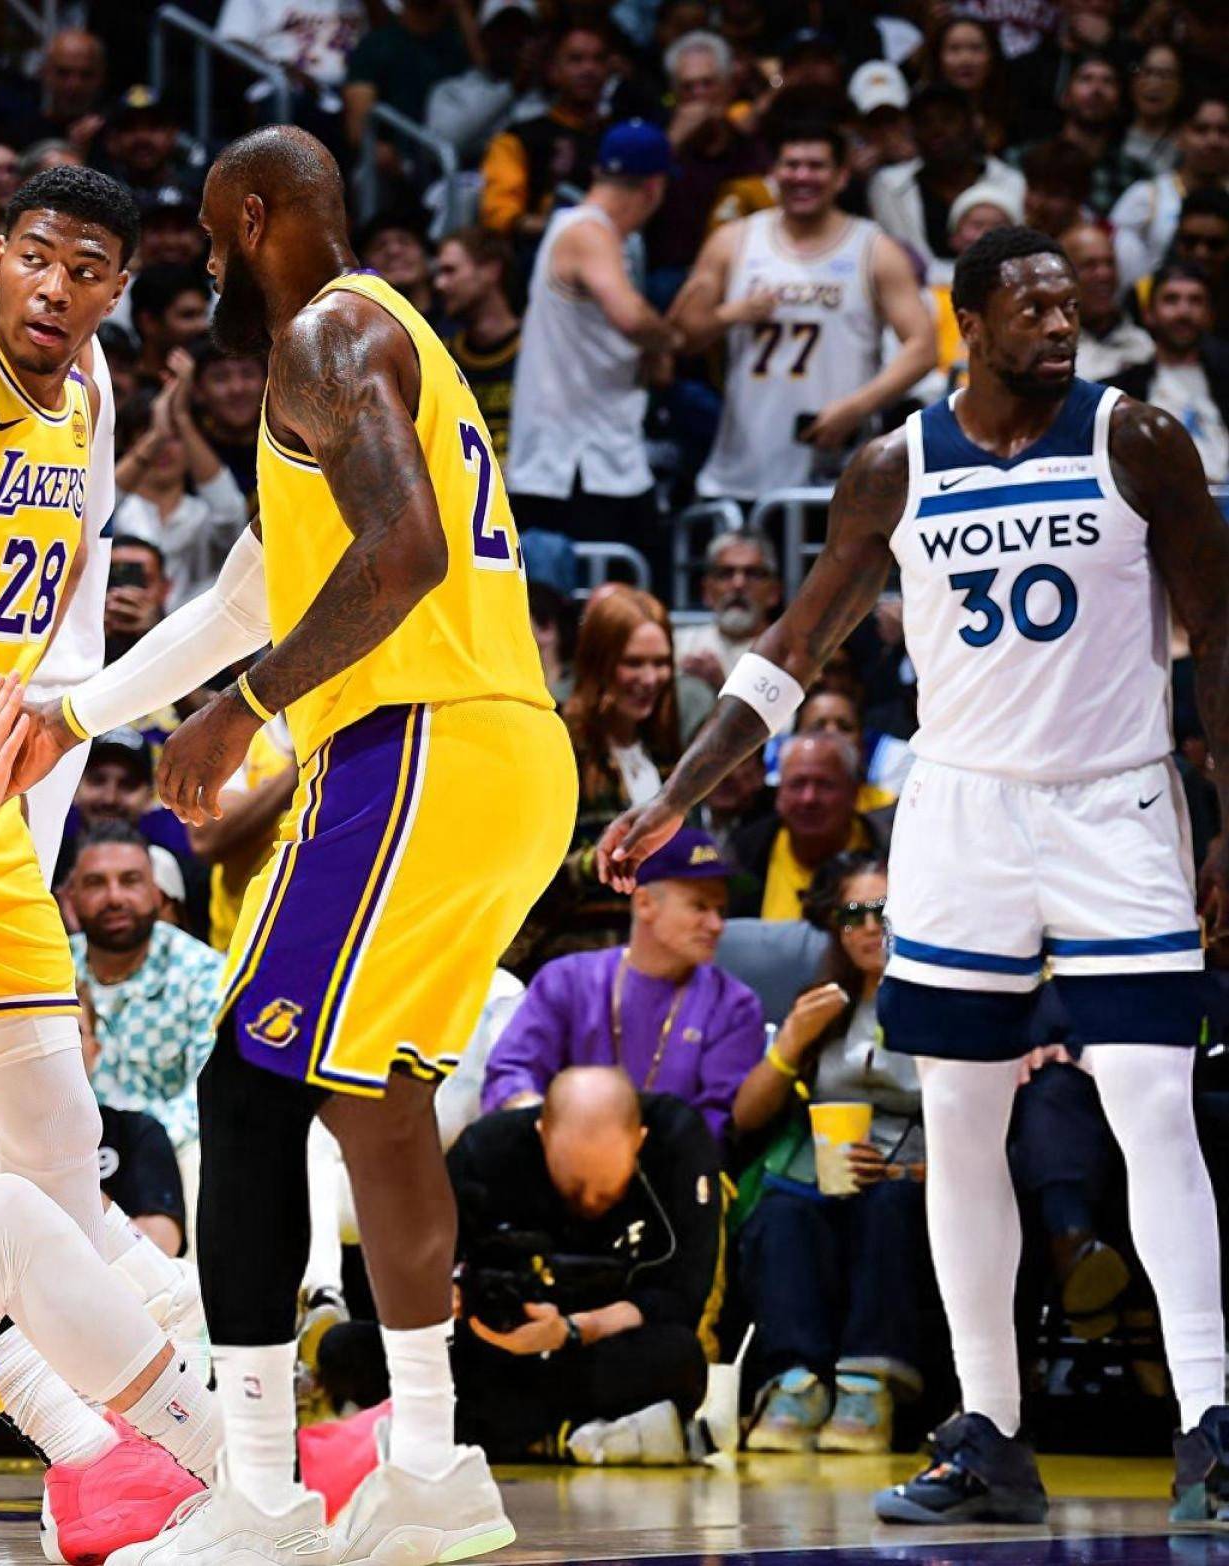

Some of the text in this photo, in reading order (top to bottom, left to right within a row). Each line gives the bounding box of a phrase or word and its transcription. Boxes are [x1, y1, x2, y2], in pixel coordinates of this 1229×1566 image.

[751, 321, 820, 378] 77
[459, 420, 524, 576] 2
[919, 512, 1101, 562] WOLVES
[948, 563, 1079, 648] 30
[753, 676, 780, 703] 30
